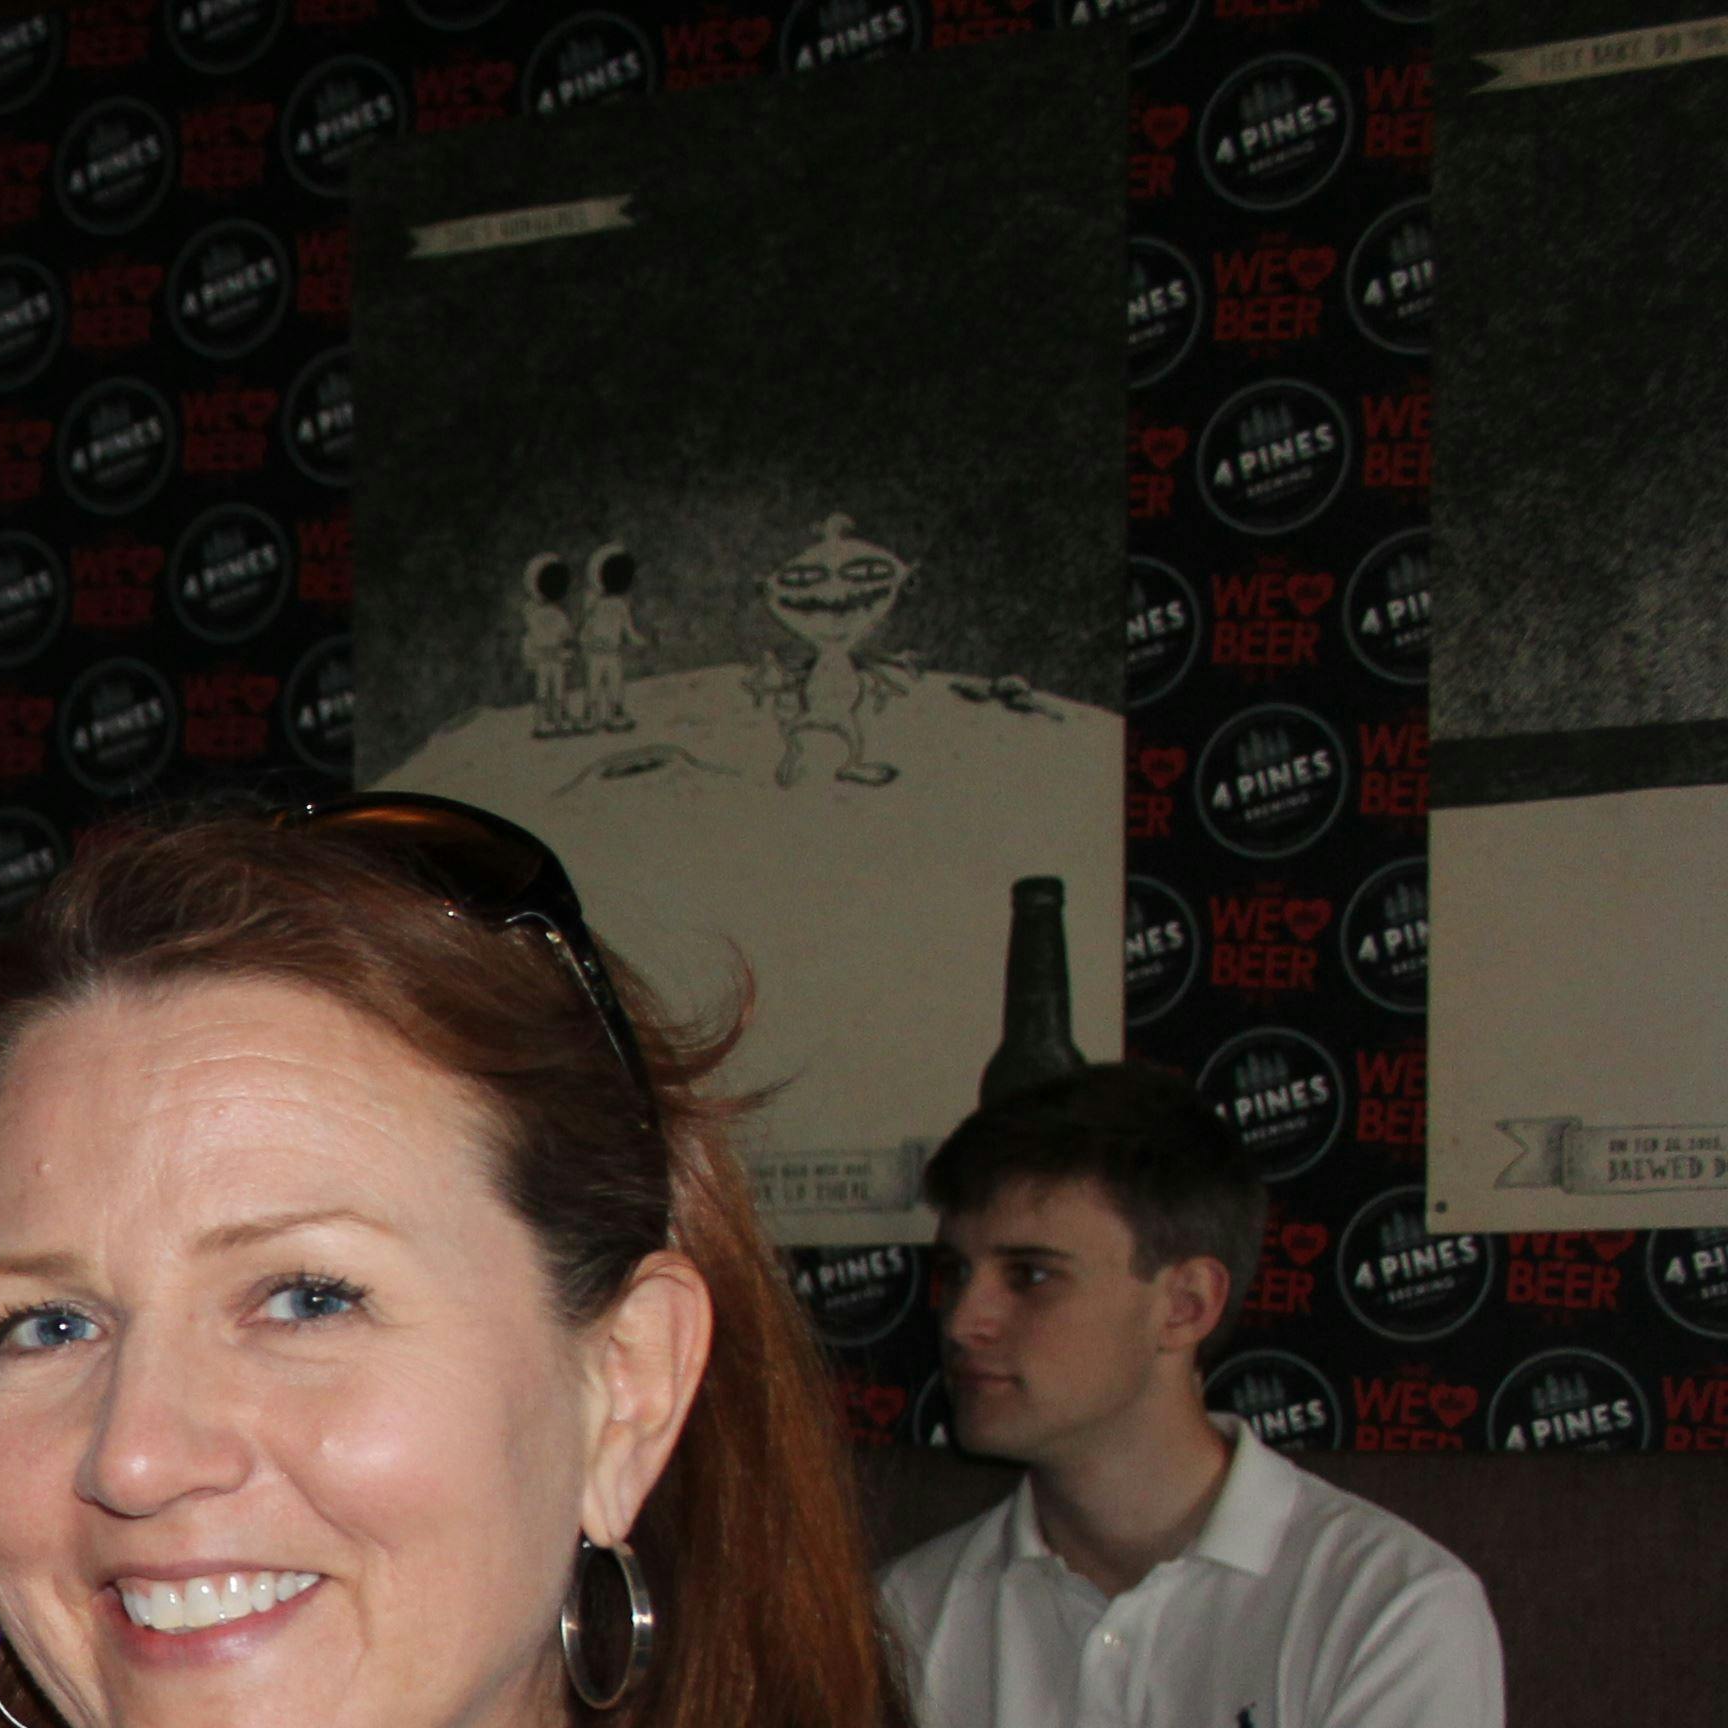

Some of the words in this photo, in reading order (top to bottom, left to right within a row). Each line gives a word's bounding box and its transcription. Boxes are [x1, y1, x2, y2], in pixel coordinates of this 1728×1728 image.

[1240, 96, 1338, 157] PINES
[1211, 295, 1325, 343] BEER
[1239, 422, 1337, 480] PINES
[1209, 619, 1323, 667] BEER
[1236, 748, 1334, 806] PINES
[1208, 895, 1283, 943] WE
[1209, 942, 1319, 992] BEER
[1234, 1073, 1331, 1126] PINES
[1379, 1234, 1480, 1286] PINES
[1505, 1257, 1623, 1312] BEER
[1352, 1374, 1431, 1427] WE
[1530, 1399, 1635, 1450] PINES
